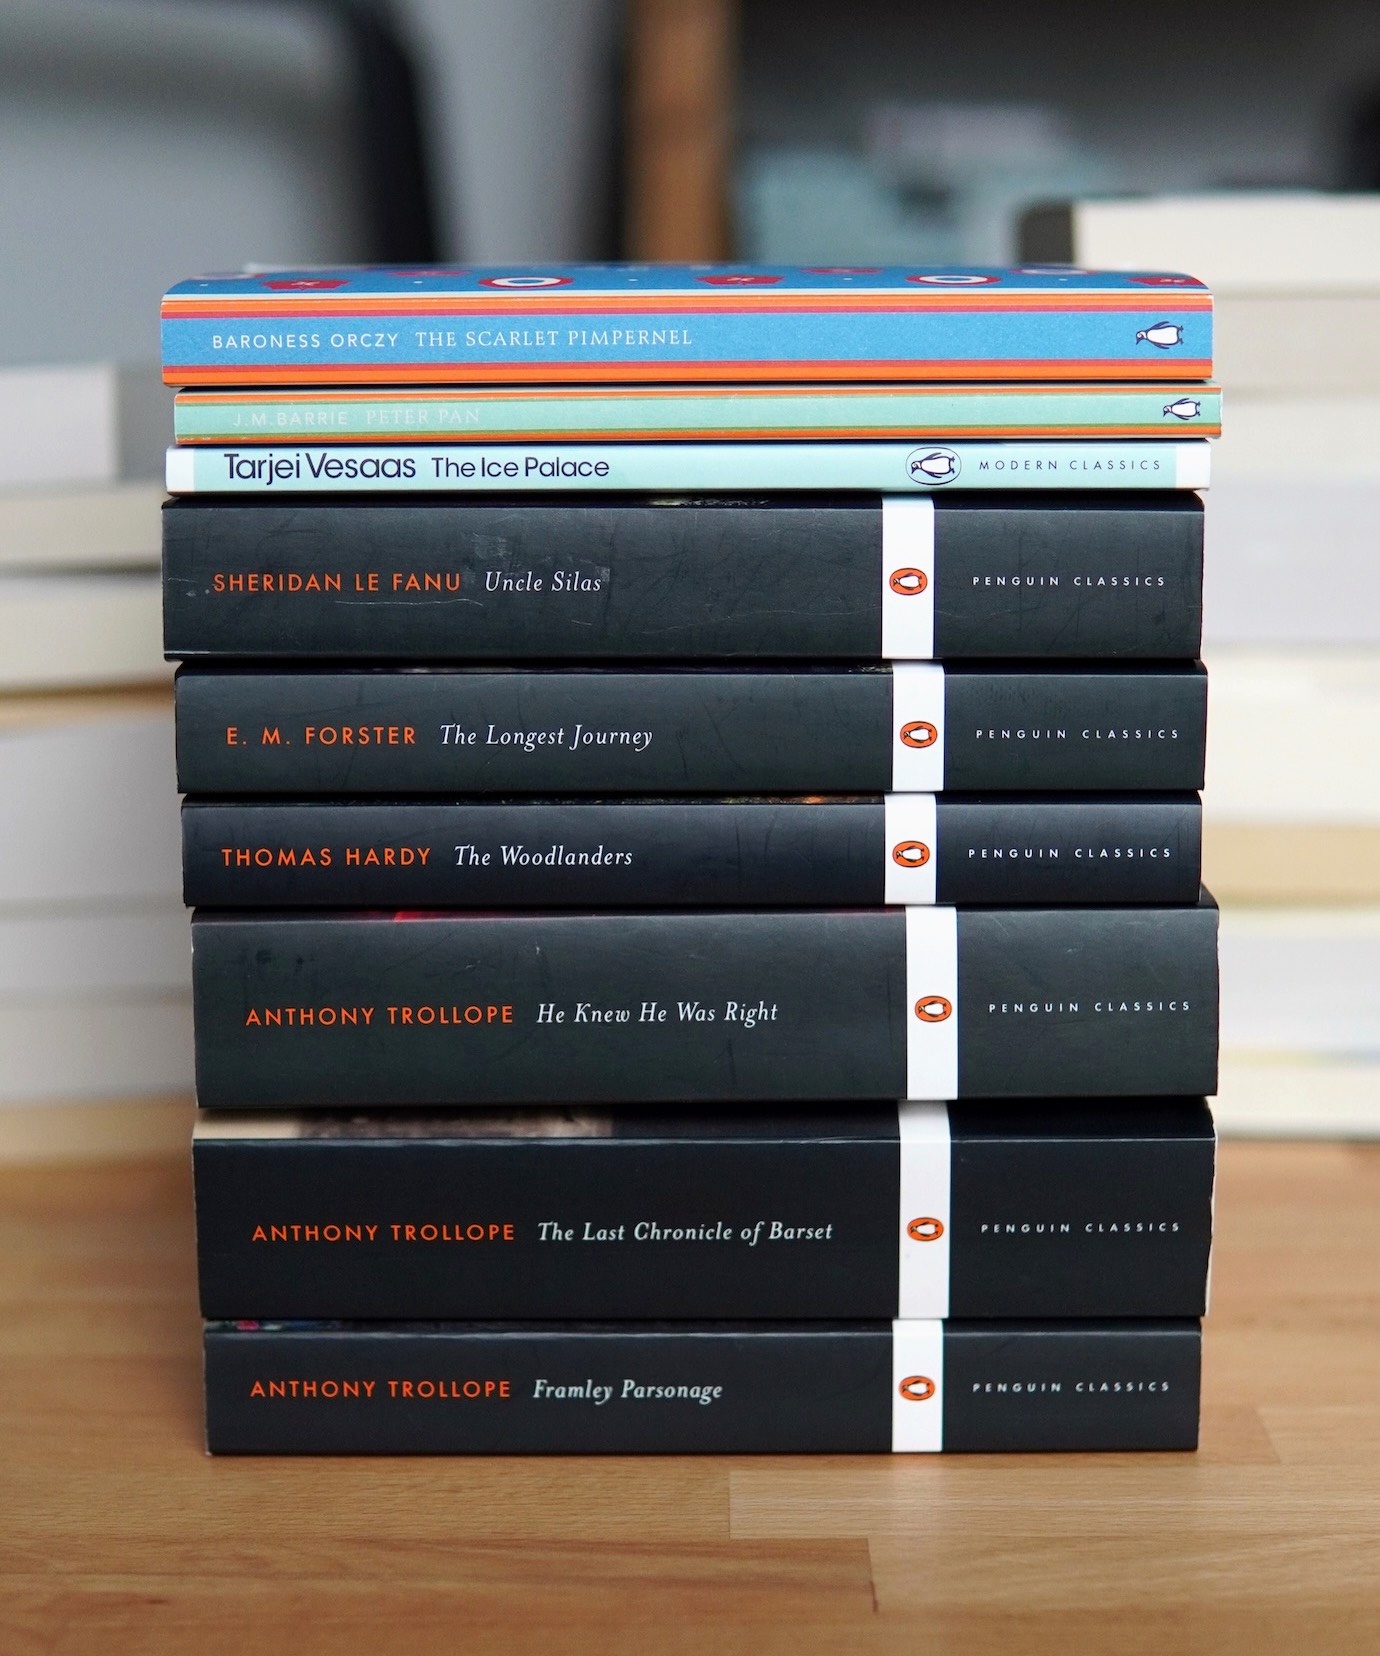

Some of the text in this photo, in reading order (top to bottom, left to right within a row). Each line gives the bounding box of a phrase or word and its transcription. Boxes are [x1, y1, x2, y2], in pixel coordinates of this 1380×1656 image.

[212, 329, 692, 349] BARONESS ORCZY THE SCARLET PIMPERNEL
[366, 409, 430, 425] PETER
[438, 408, 480, 423] PAN
[223, 452, 610, 486] Tarjei Vesaas The Ice Palace
[978, 459, 1160, 471] MODERN CLASSICS
[213, 570, 602, 592] SHERIDAN LE FANU Uncle Silas
[972, 576, 1164, 587] PENGUIN CLASSICS
[227, 723, 653, 753] E. M. FORSTER The Longest Journey
[976, 729, 1178, 739] PENGUIN CLASSICS
[221, 844, 633, 867] THOMAS HARDY The Woodlanders
[968, 848, 1170, 859] PENGUIN CLASSICS
[245, 1000, 778, 1029] ANTHONY TROLLOPE He Knew He Was Right
[989, 1001, 1190, 1013] PENGUIN CLASSICS
[252, 1220, 833, 1247] ANTHONY TROLLOPE The Last Chronicle of Barset
[981, 1222, 1179, 1233] PENGUIN CLASSICS
[250, 1378, 723, 1406] ANTHONY TROLLOPE Framley Parsonage
[972, 1381, 1169, 1393] PENGUIN CLASSICS
